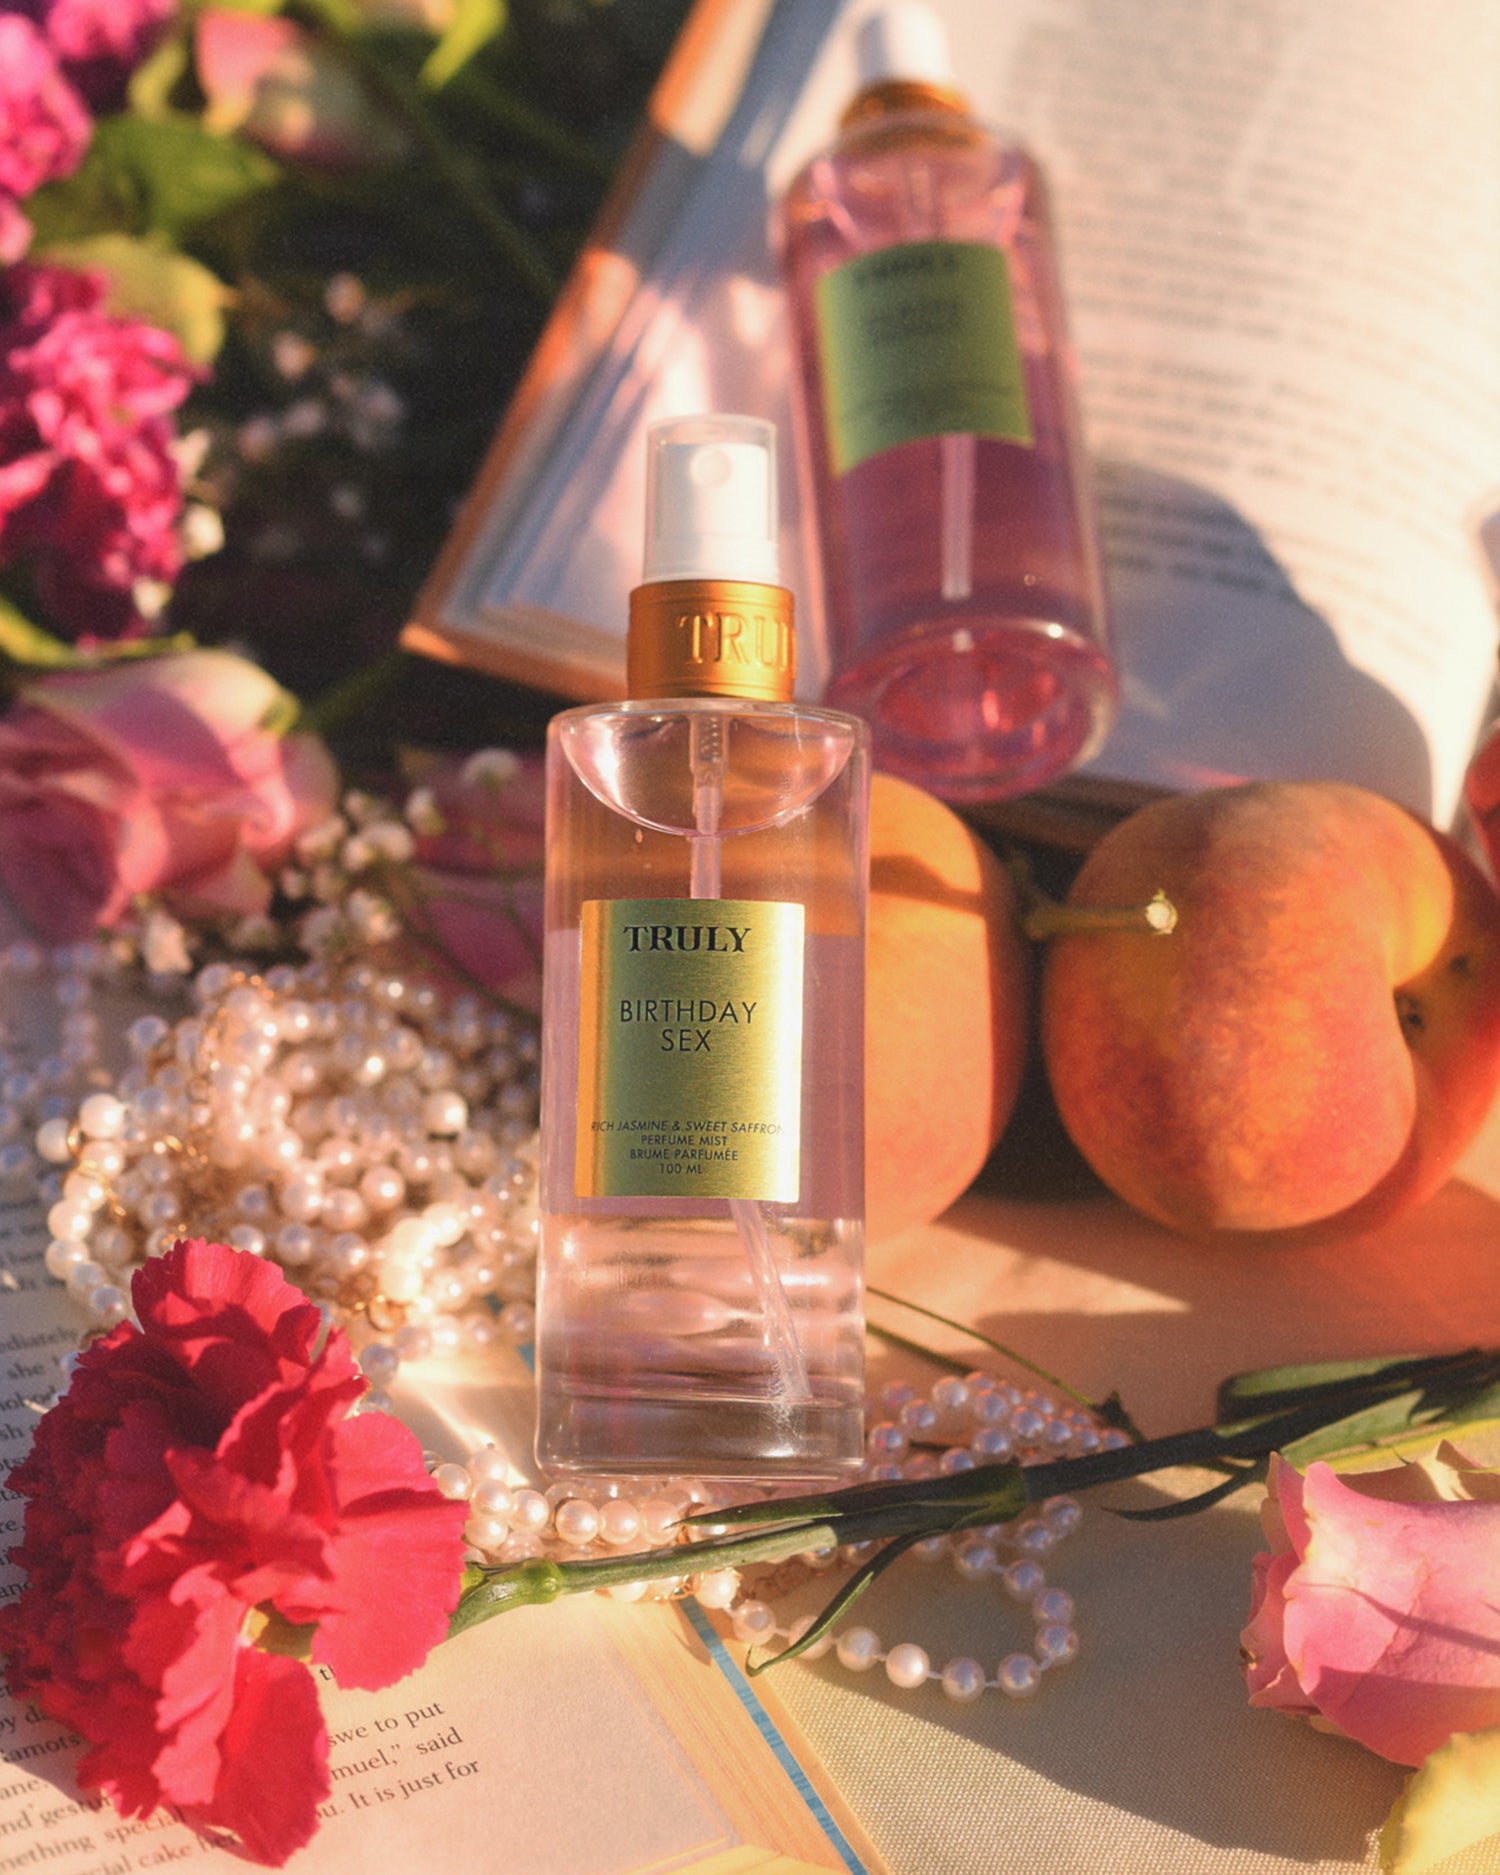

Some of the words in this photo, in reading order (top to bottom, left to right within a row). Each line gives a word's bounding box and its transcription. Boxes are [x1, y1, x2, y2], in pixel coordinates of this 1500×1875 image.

[622, 925, 752, 953] TRULY
[620, 1000, 757, 1024] BIRTHDAY
[661, 1029, 711, 1051] SEX
[591, 1121, 614, 1132] RICH
[616, 1120, 667, 1132] JASMINE
[672, 1120, 681, 1131] &
[685, 1121, 727, 1132] SWEET
[641, 1135, 694, 1146] PERFUME
[699, 1135, 728, 1146] MIST
[630, 1148, 669, 1160] BRUME
[674, 1147, 739, 1161] PARFUMÉE
[659, 1163, 681, 1174] 100
[686, 1163, 703, 1174] ML
[374, 1717, 399, 1733] to
[404, 1702, 446, 1728] put
[416, 1726, 464, 1755] said
[348, 1792, 371, 1809] It
[374, 1786, 396, 1802] is
[397, 1771, 443, 1801] just
[445, 1760, 481, 1780] for
[138, 1844, 191, 1868] cake
